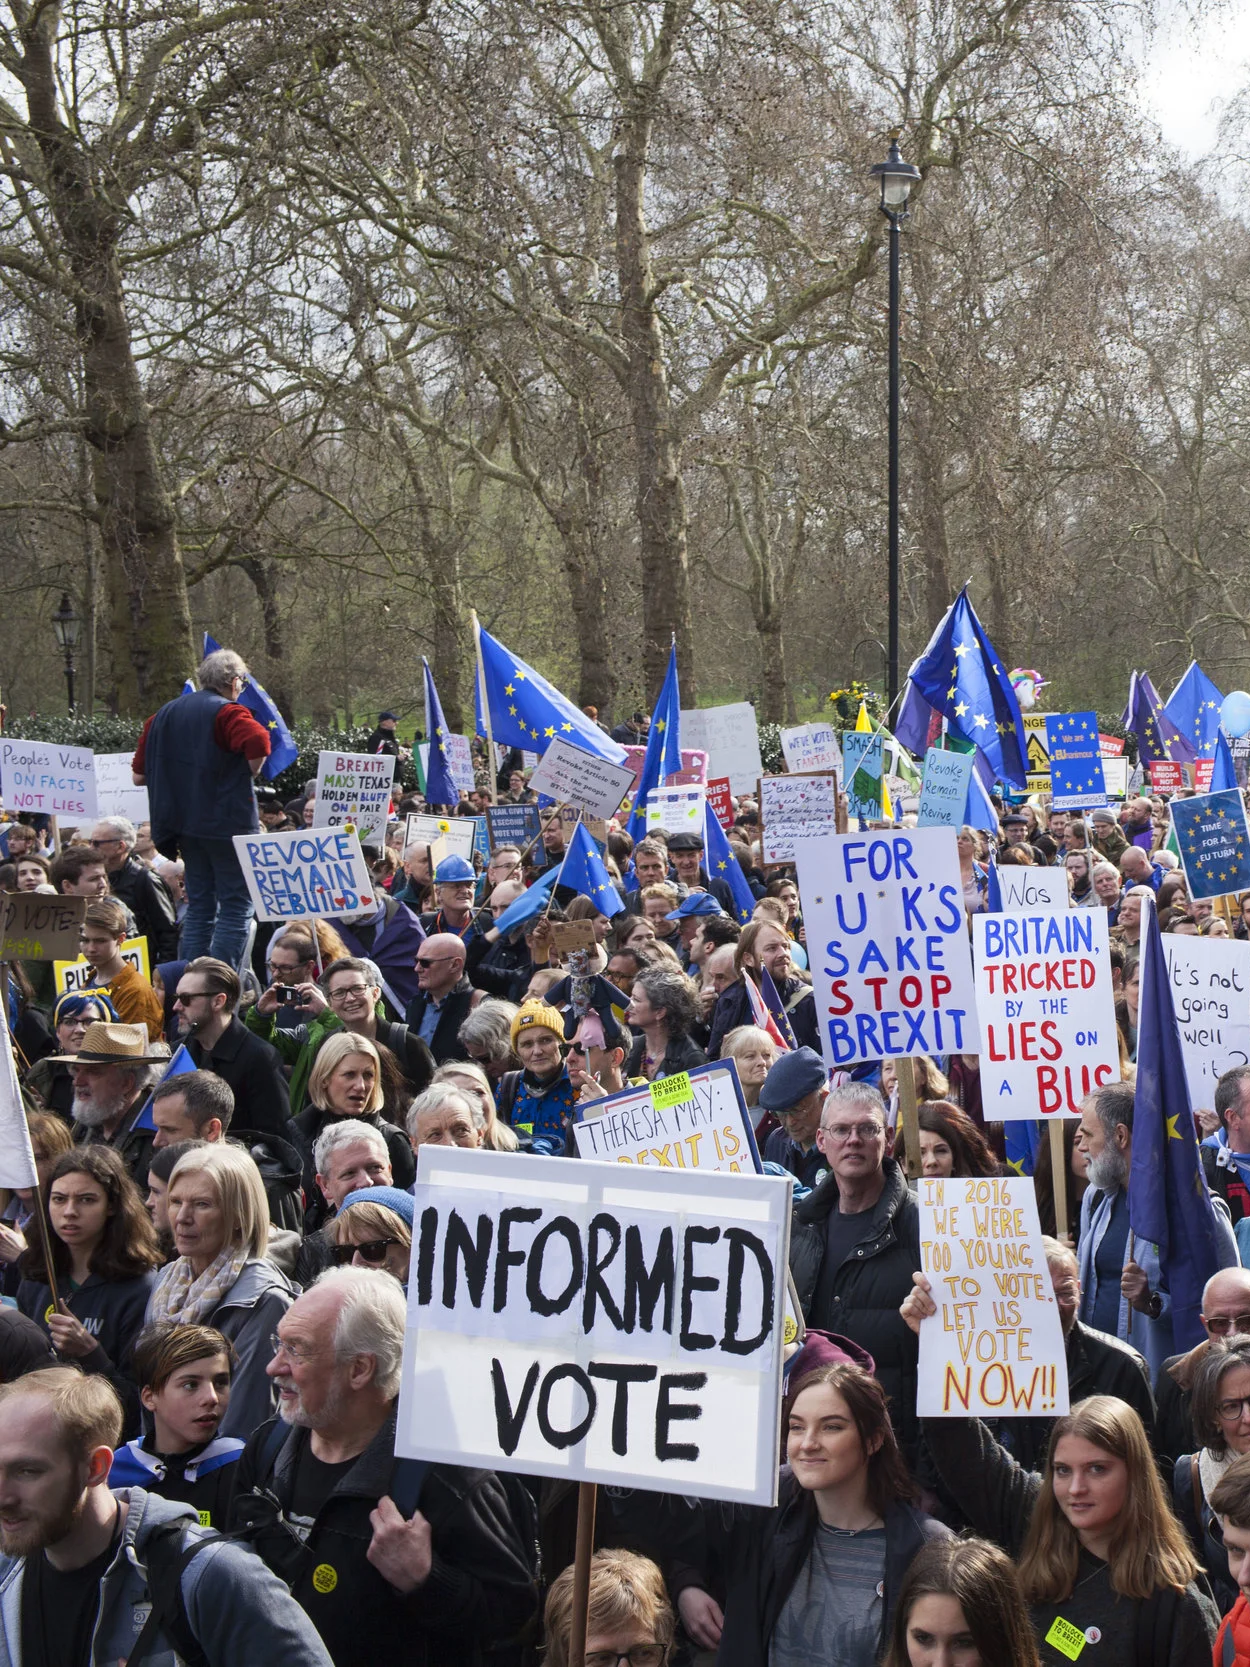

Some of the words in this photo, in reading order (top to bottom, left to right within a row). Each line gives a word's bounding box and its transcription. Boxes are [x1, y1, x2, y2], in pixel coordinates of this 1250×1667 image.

[4, 745, 49, 772] People's
[847, 735, 882, 756] SMASH
[336, 757, 385, 773] BREXIT:
[557, 755, 583, 771] Revoke
[584, 768, 608, 783] Article
[610, 780, 620, 788] 50
[796, 752, 837, 769] FANTASY
[929, 754, 963, 778] Revoke
[14, 772, 35, 787] ON
[40, 775, 85, 792] FACTS
[359, 776, 391, 789] TEXAS
[550, 782, 570, 794] STOP
[571, 793, 600, 808] BREXIT
[583, 784, 607, 798] people
[926, 780, 957, 795] Remain
[14, 793, 45, 807] NOT
[53, 798, 85, 812] LIES
[331, 802, 348, 812] ON
[360, 803, 381, 812] PAIR
[360, 792, 387, 802] BLUFF
[328, 816, 341, 826] OF
[921, 803, 951, 821] Revive
[1200, 822, 1222, 832] TIME
[247, 834, 354, 868] REVOKE
[1202, 838, 1219, 847] FOR
[1220, 836, 1227, 844] A
[843, 838, 918, 883] FOR
[1200, 853, 1211, 862] EU
[1212, 848, 1236, 859] TURN
[254, 862, 356, 895] REMAIN
[1001, 872, 1051, 908] Was
[262, 888, 358, 916] REBUILD
[985, 915, 1100, 957] BRITAIN,
[824, 936, 945, 977] SAKE
[983, 958, 1096, 995] TRICKED
[1209, 968, 1244, 993] not
[829, 974, 952, 1016] STOP
[1005, 1000, 1022, 1017] BY
[1039, 997, 1068, 1015] THE
[1176, 997, 1229, 1023] going
[828, 1009, 966, 1063] BREXIT
[987, 1020, 1062, 1062] LIES
[1075, 1030, 1098, 1046] ON
[652, 1075, 685, 1091] BOLLOCKS
[654, 1090, 662, 1098] TO
[665, 1082, 687, 1094] BREXIT
[1000, 1079, 1013, 1096] A
[578, 1105, 668, 1153] THERESA
[713, 1126, 740, 1160] IS
[924, 1180, 944, 1206] IN
[965, 1180, 1011, 1205] 2016
[934, 1207, 958, 1236] WE
[972, 1207, 1028, 1238] WERE
[922, 1242, 950, 1272] TOO
[960, 1239, 1033, 1269] YOUNG
[417, 1206, 774, 1355] INFORMED
[944, 1276, 981, 1298] TO
[994, 1273, 1053, 1302] VOTE.
[943, 1302, 978, 1331] LET
[993, 1301, 1022, 1326] US
[957, 1329, 1032, 1365] VOTE
[944, 1362, 1056, 1412] NOW!!
[491, 1357, 708, 1461] VOTE
[1057, 1619, 1084, 1641] BOLLOCKS
[1062, 1631, 1081, 1648] BREXIT
